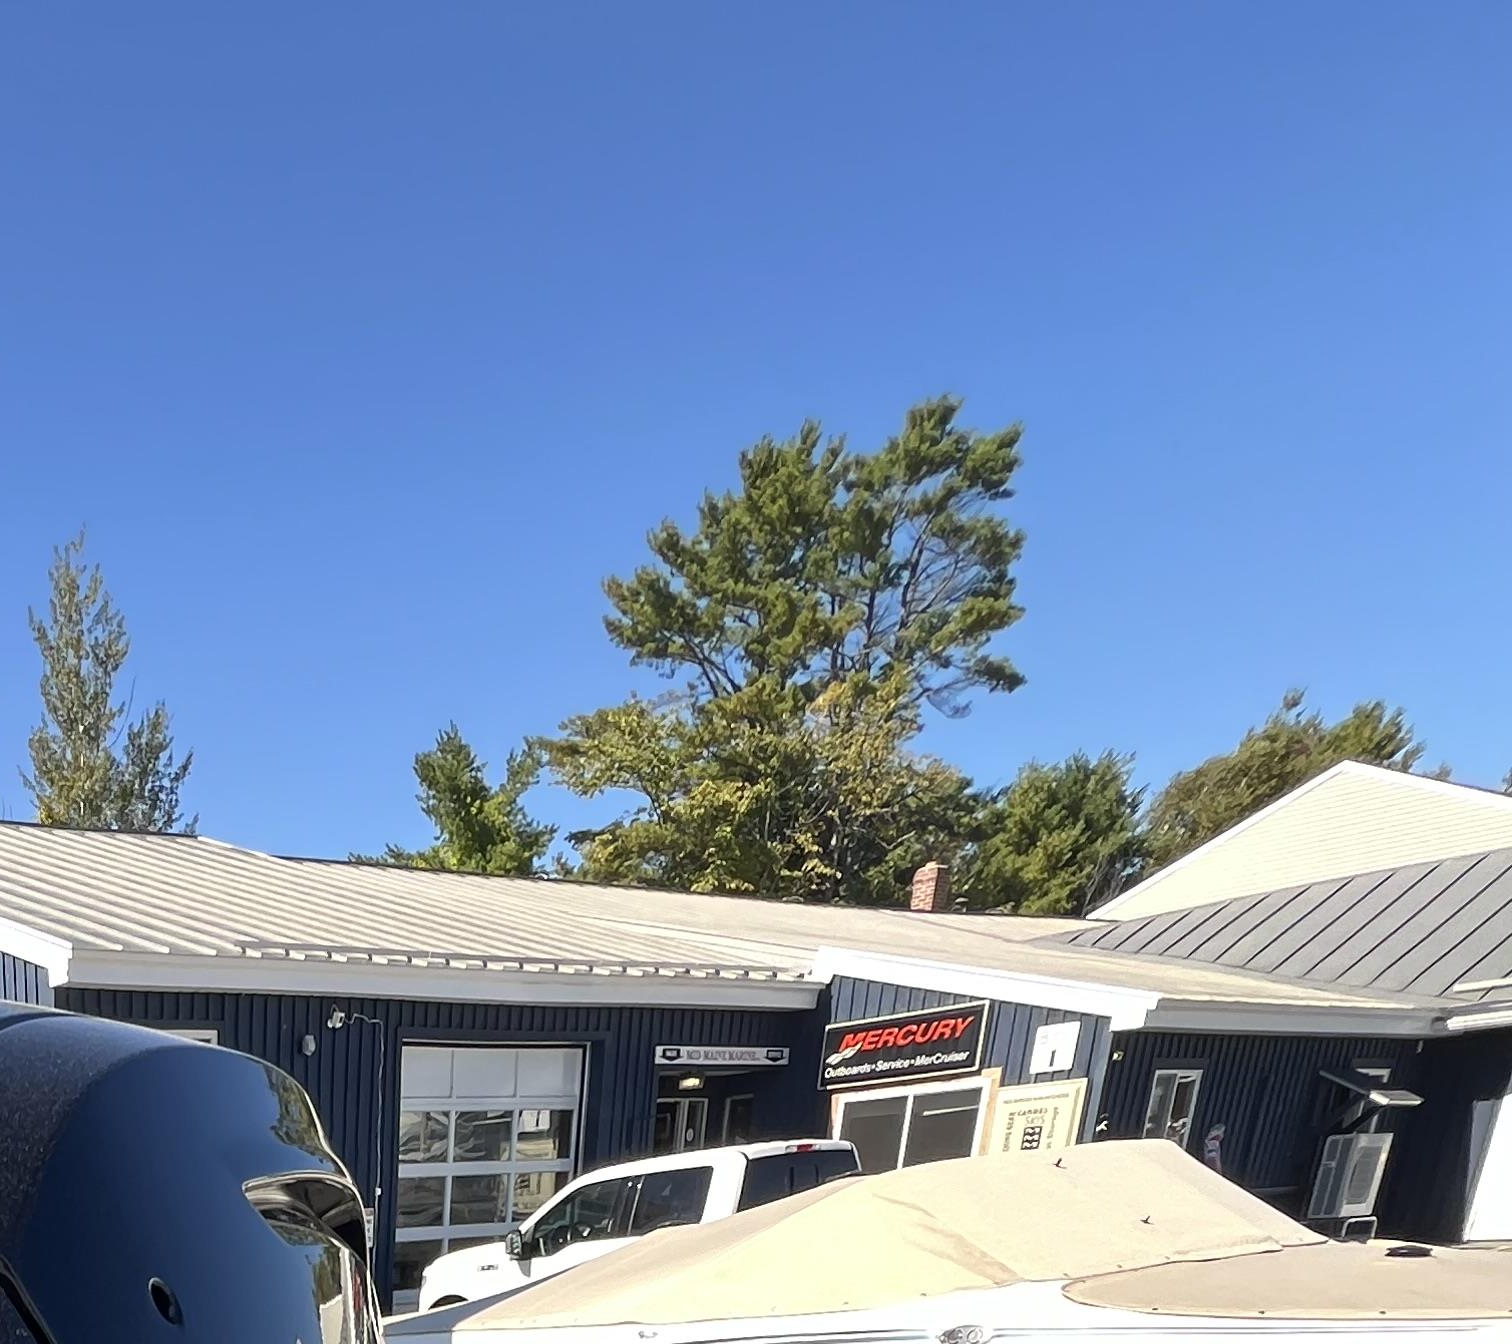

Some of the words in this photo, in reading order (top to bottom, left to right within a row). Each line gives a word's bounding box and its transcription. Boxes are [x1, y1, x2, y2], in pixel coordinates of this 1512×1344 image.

[838, 1015, 975, 1053] MERCURY
[824, 1062, 873, 1079] Outboards
[875, 1059, 910, 1073] Service
[914, 1051, 970, 1067] MerCruiser
